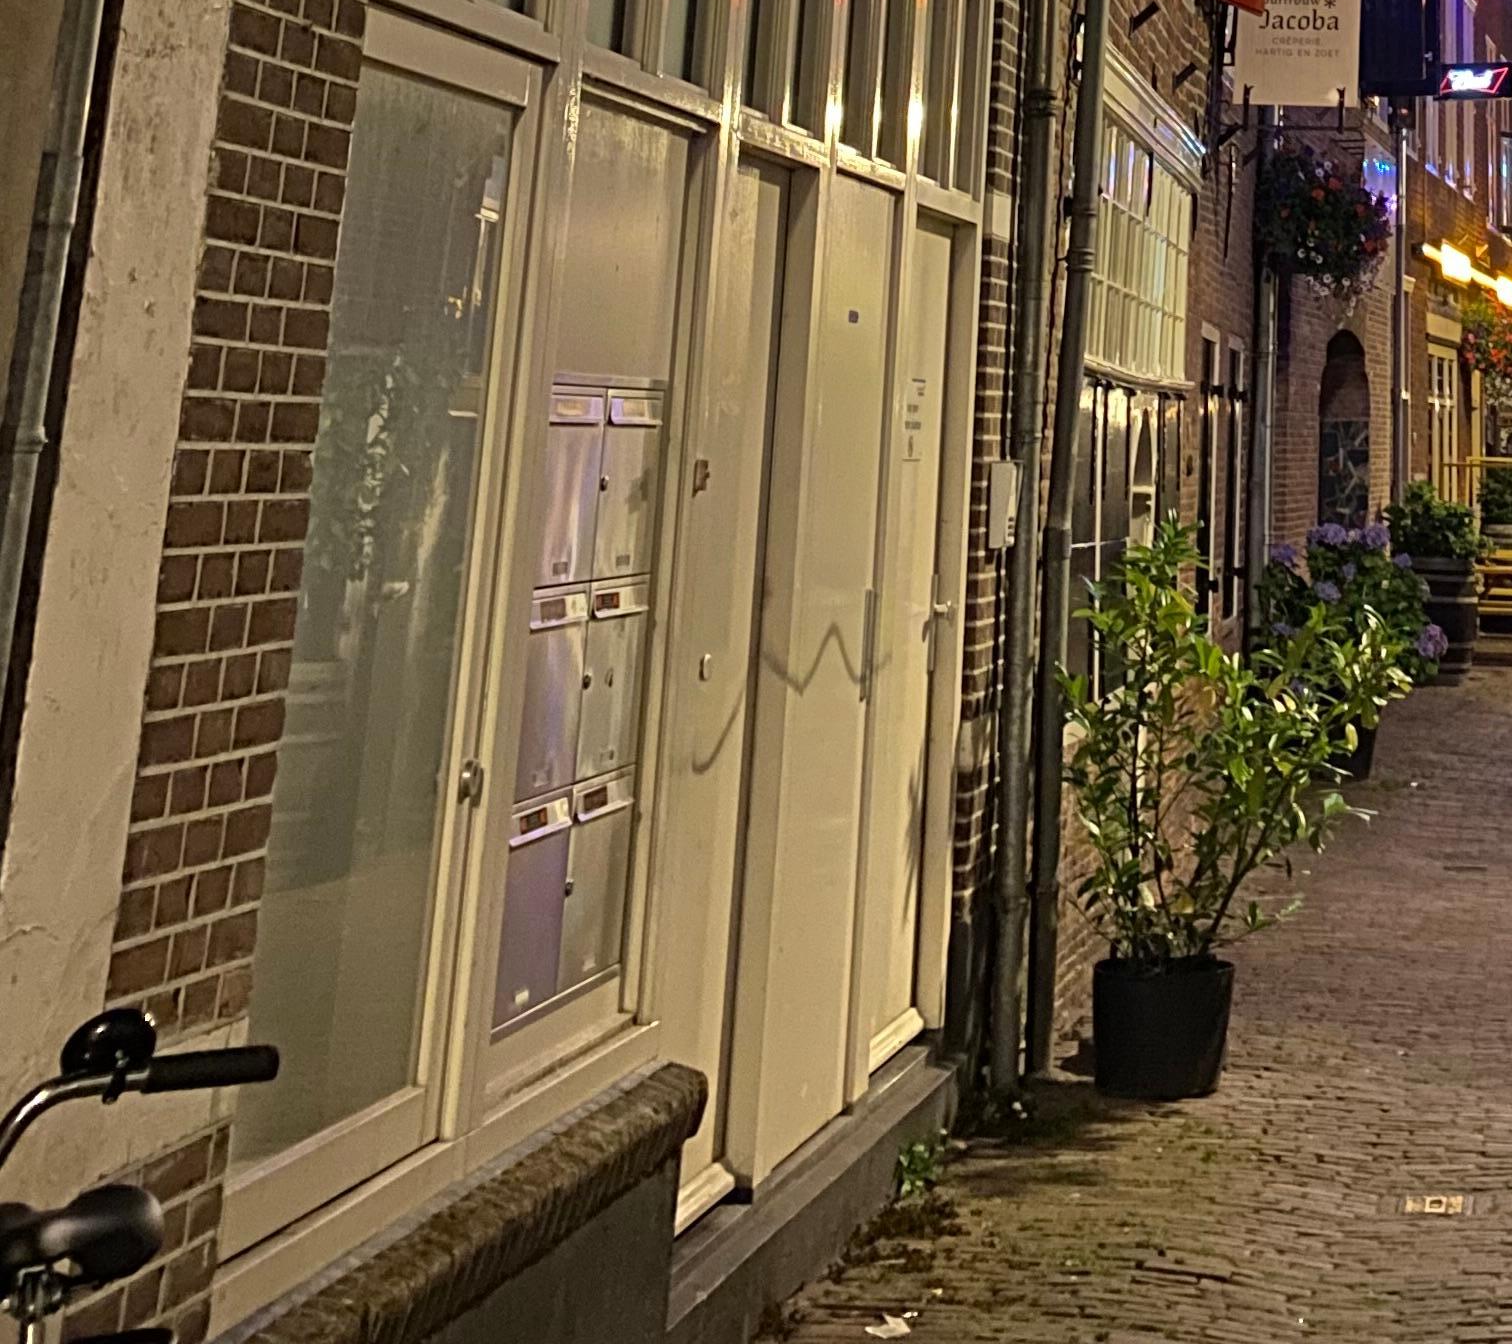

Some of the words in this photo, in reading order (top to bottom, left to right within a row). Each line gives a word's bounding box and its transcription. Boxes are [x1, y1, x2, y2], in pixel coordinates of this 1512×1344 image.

[1259, 9, 1339, 30] Jacoba
[1256, 47, 1293, 57] HARTIG
[1297, 48, 1310, 57] EN
[1314, 48, 1340, 58] ZOET
